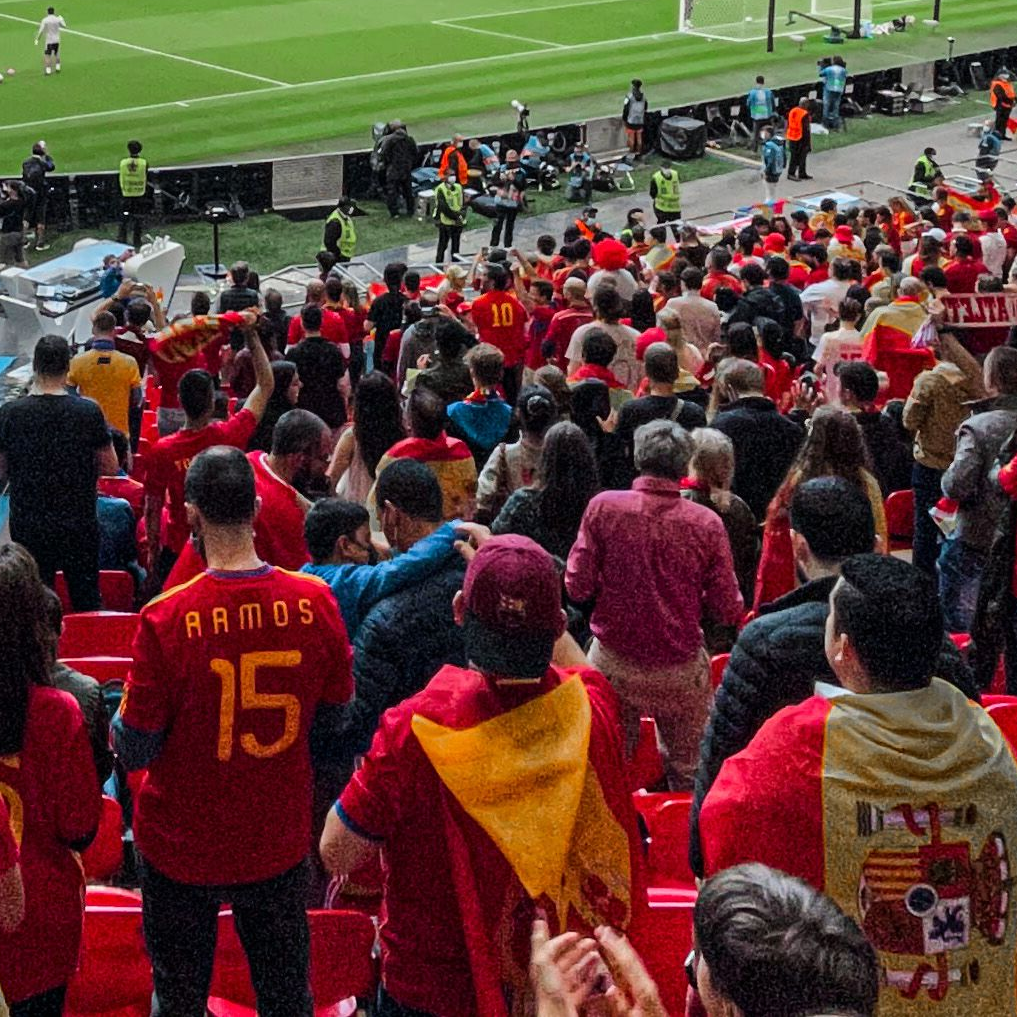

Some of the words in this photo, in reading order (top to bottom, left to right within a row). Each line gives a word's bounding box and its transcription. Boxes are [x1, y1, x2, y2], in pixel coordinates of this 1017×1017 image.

[492, 302, 513, 327] 10
[185, 598, 314, 639] RAMOS
[210, 649, 302, 761] 15
